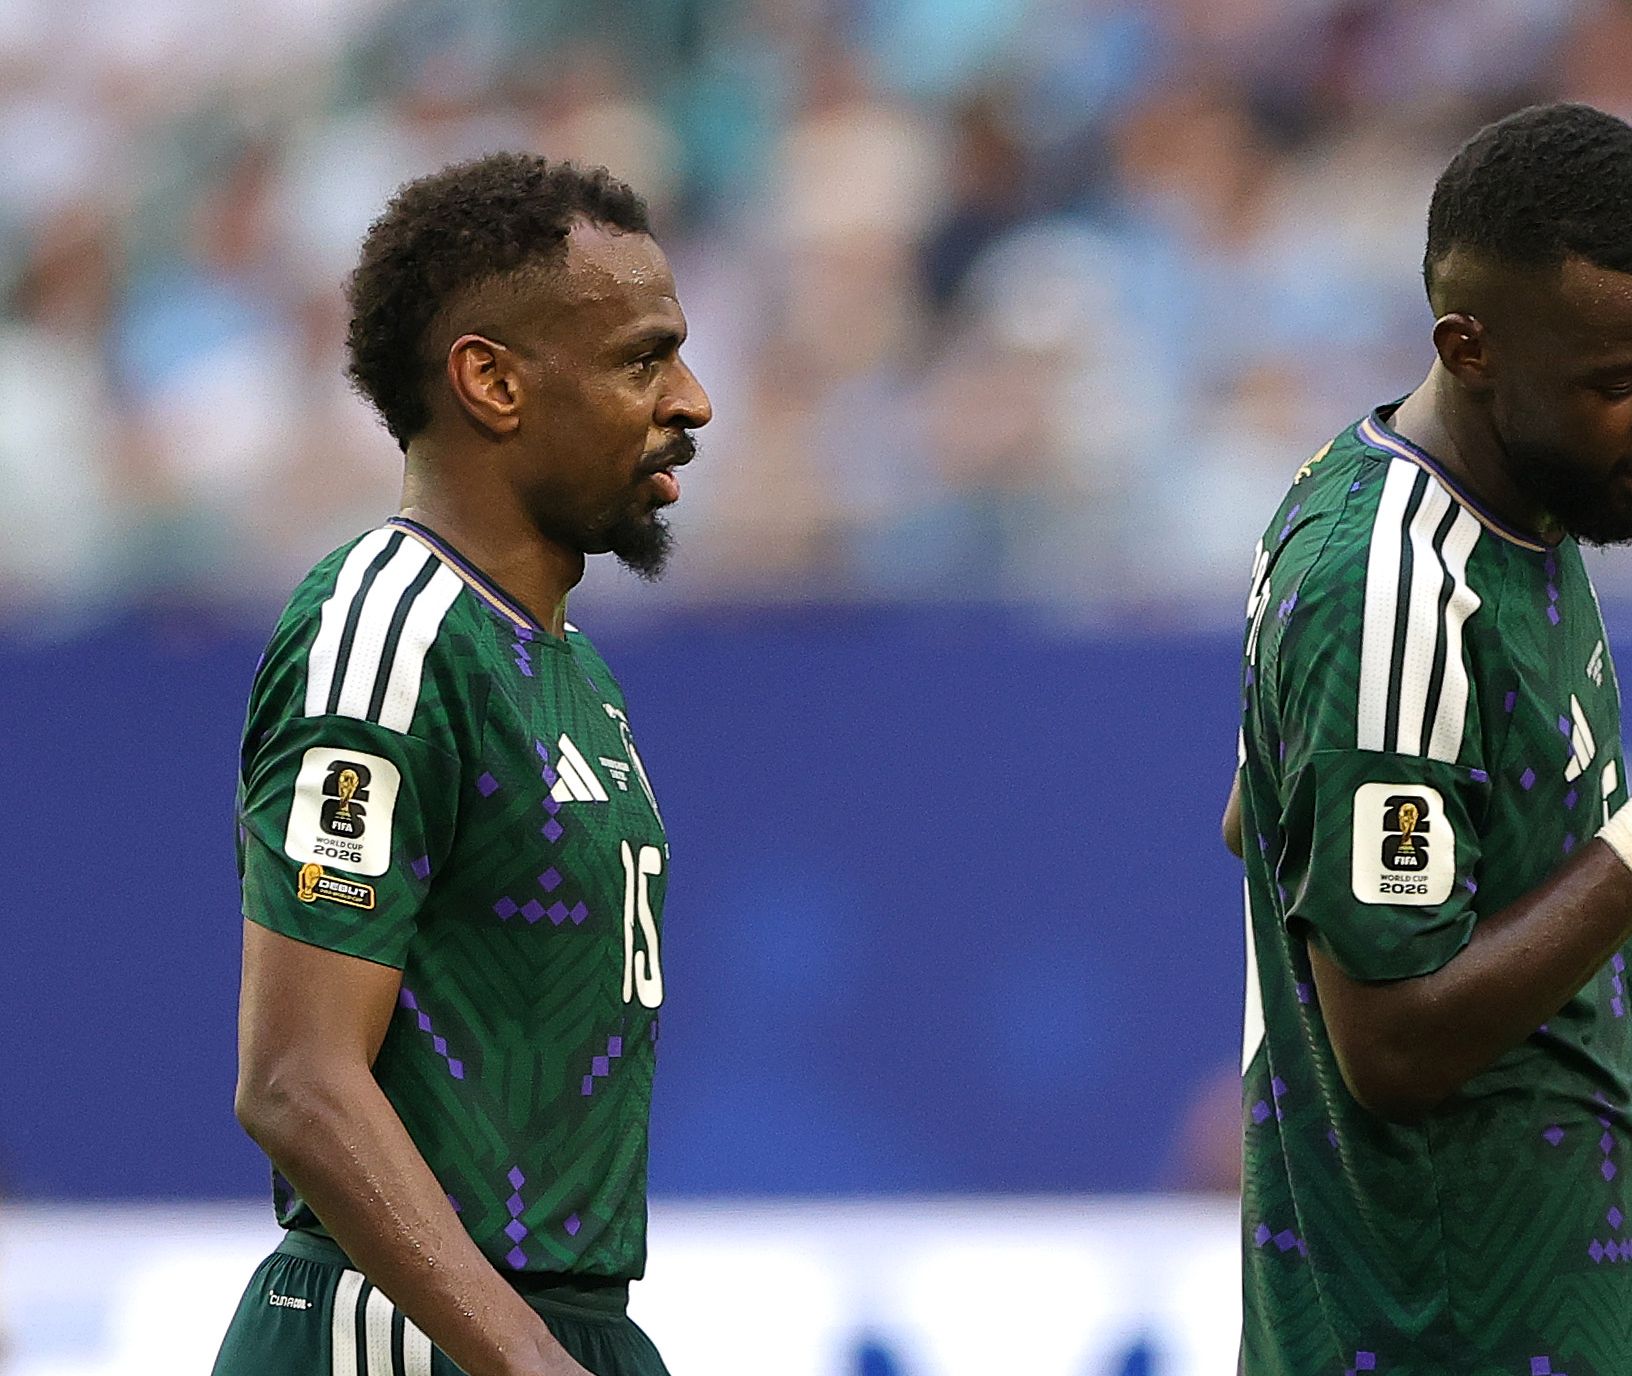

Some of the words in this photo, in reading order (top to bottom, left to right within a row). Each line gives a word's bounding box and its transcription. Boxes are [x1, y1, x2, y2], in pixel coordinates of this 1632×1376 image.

[331, 820, 354, 833] FIFA
[316, 836, 346, 848] WORLD
[347, 841, 364, 851] CUP
[313, 844, 362, 863] 2026
[1394, 856, 1418, 866] FIFA
[1380, 874, 1411, 882] WORLD
[318, 879, 369, 898] DEBUT
[1379, 882, 1428, 895] 2026
[621, 840, 663, 1008] 15
